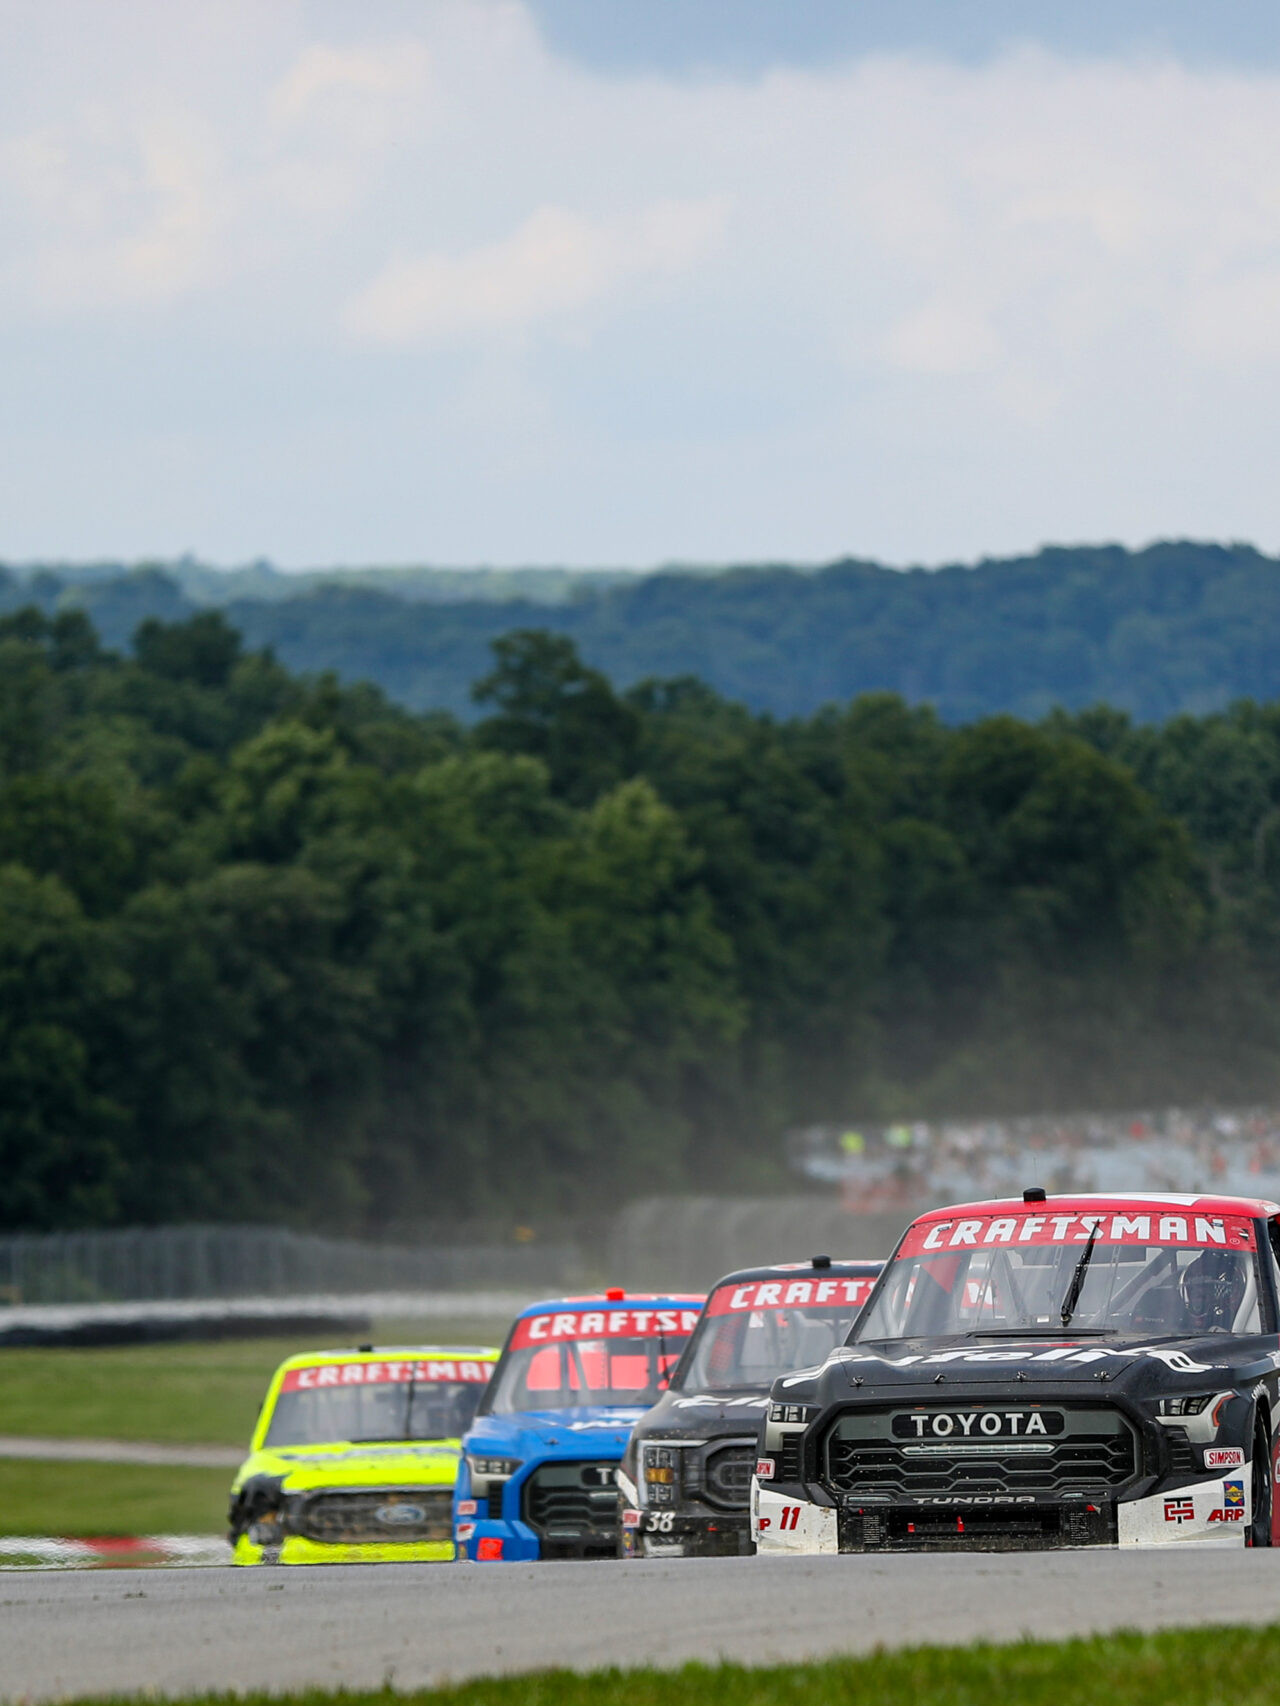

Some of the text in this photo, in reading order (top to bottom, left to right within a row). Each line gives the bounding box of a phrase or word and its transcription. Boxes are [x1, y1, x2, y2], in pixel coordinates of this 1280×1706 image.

[922, 1214, 1227, 1250] CRAFTSMAN
[910, 1412, 1048, 1437] TOYOTA
[1208, 1451, 1241, 1465] SIMPSON
[912, 1495, 1036, 1505] TUNDRA
[646, 1511, 676, 1533] 38
[779, 1506, 801, 1531] 11
[1207, 1508, 1245, 1522] ARP
